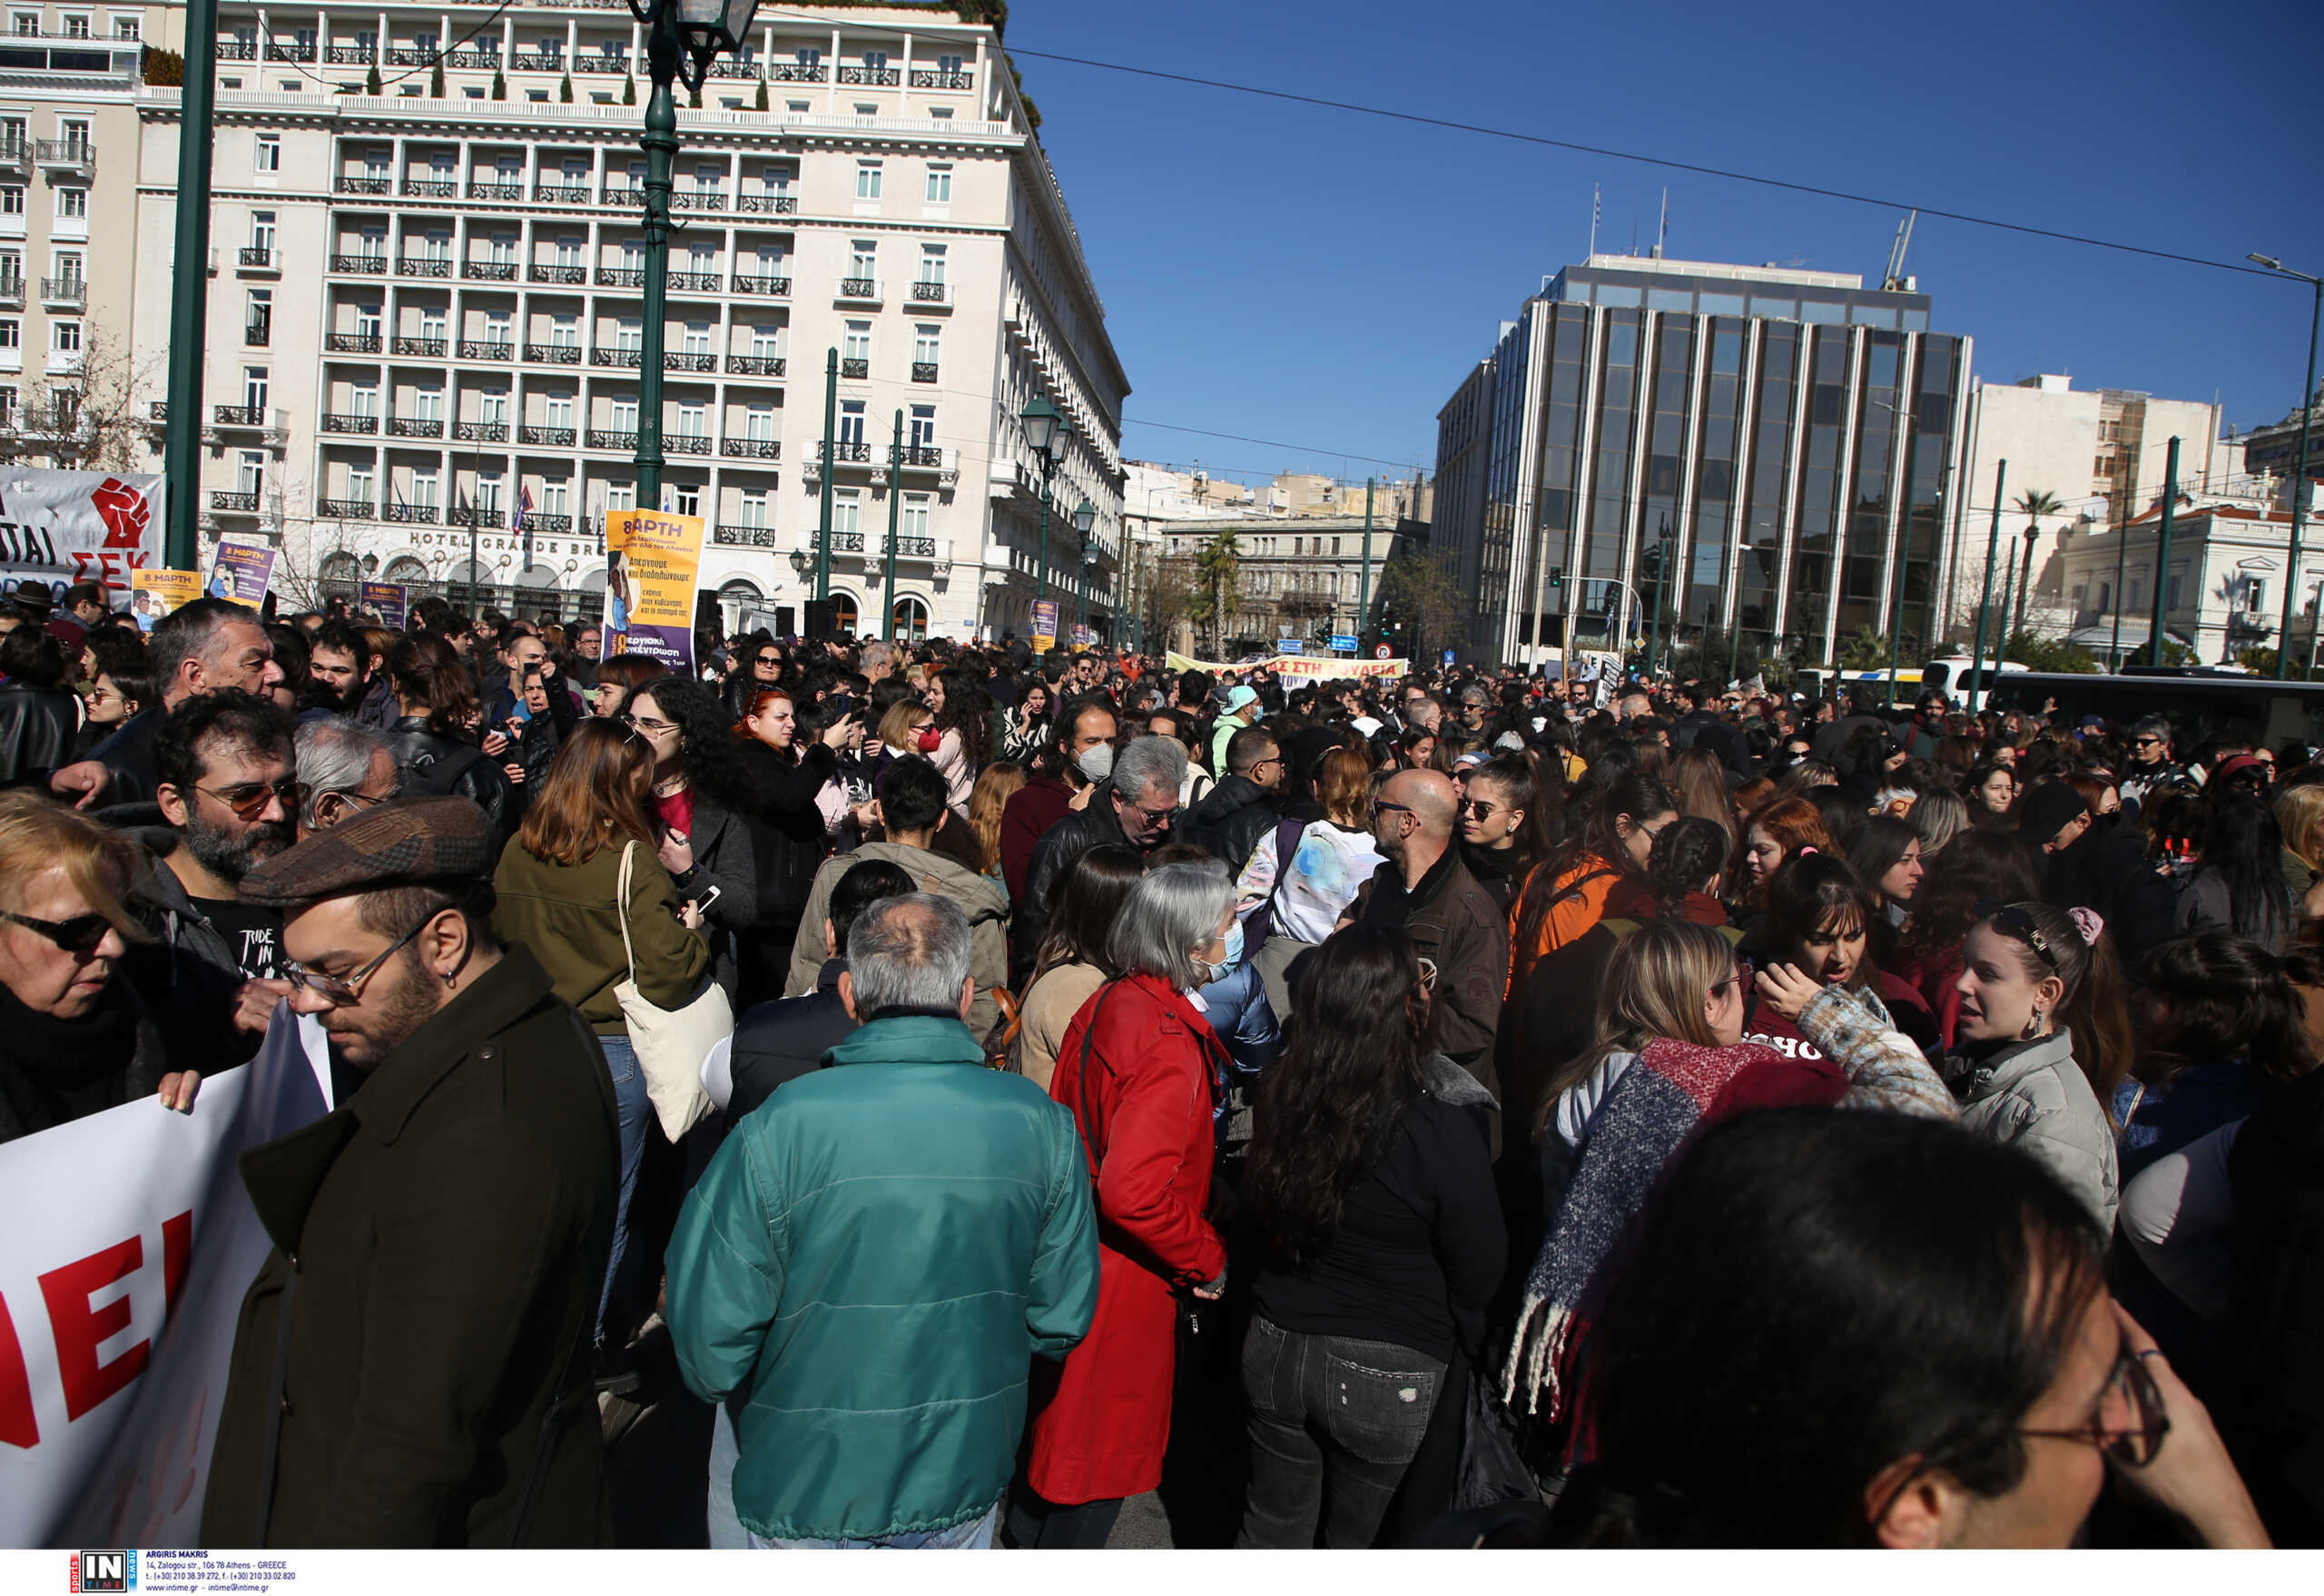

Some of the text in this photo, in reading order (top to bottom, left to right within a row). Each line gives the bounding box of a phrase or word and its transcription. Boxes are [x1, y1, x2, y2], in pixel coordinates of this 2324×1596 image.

[623, 520, 633, 535] 8
[0, 522, 56, 566] ΤΑΙ
[409, 532, 470, 547] HOTEL
[482, 537, 558, 553] GRANDE
[154, 574, 192, 584] ΜΑΡΤΗ
[1293, 661, 1322, 675] ΣΤΗ
